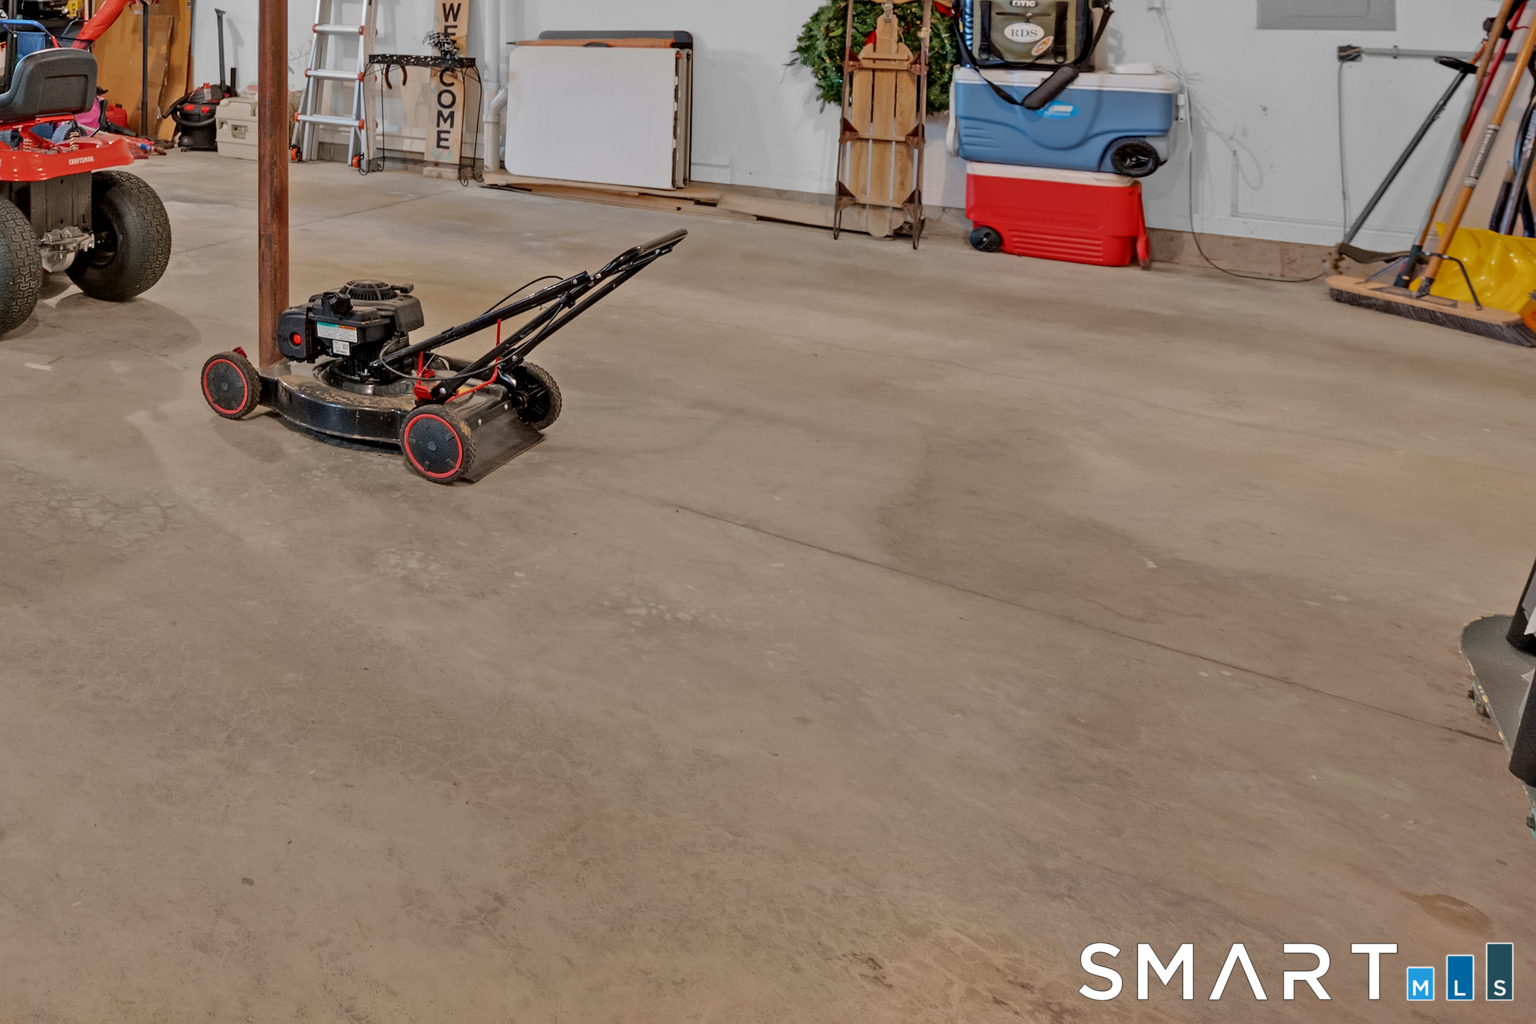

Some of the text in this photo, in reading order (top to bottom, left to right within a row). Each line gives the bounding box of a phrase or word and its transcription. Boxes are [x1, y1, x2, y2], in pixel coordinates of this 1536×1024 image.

[1011, 29, 1038, 37] RDS
[435, 2, 462, 150] WECOME
[68, 156, 95, 165] CRAFTSMAN
